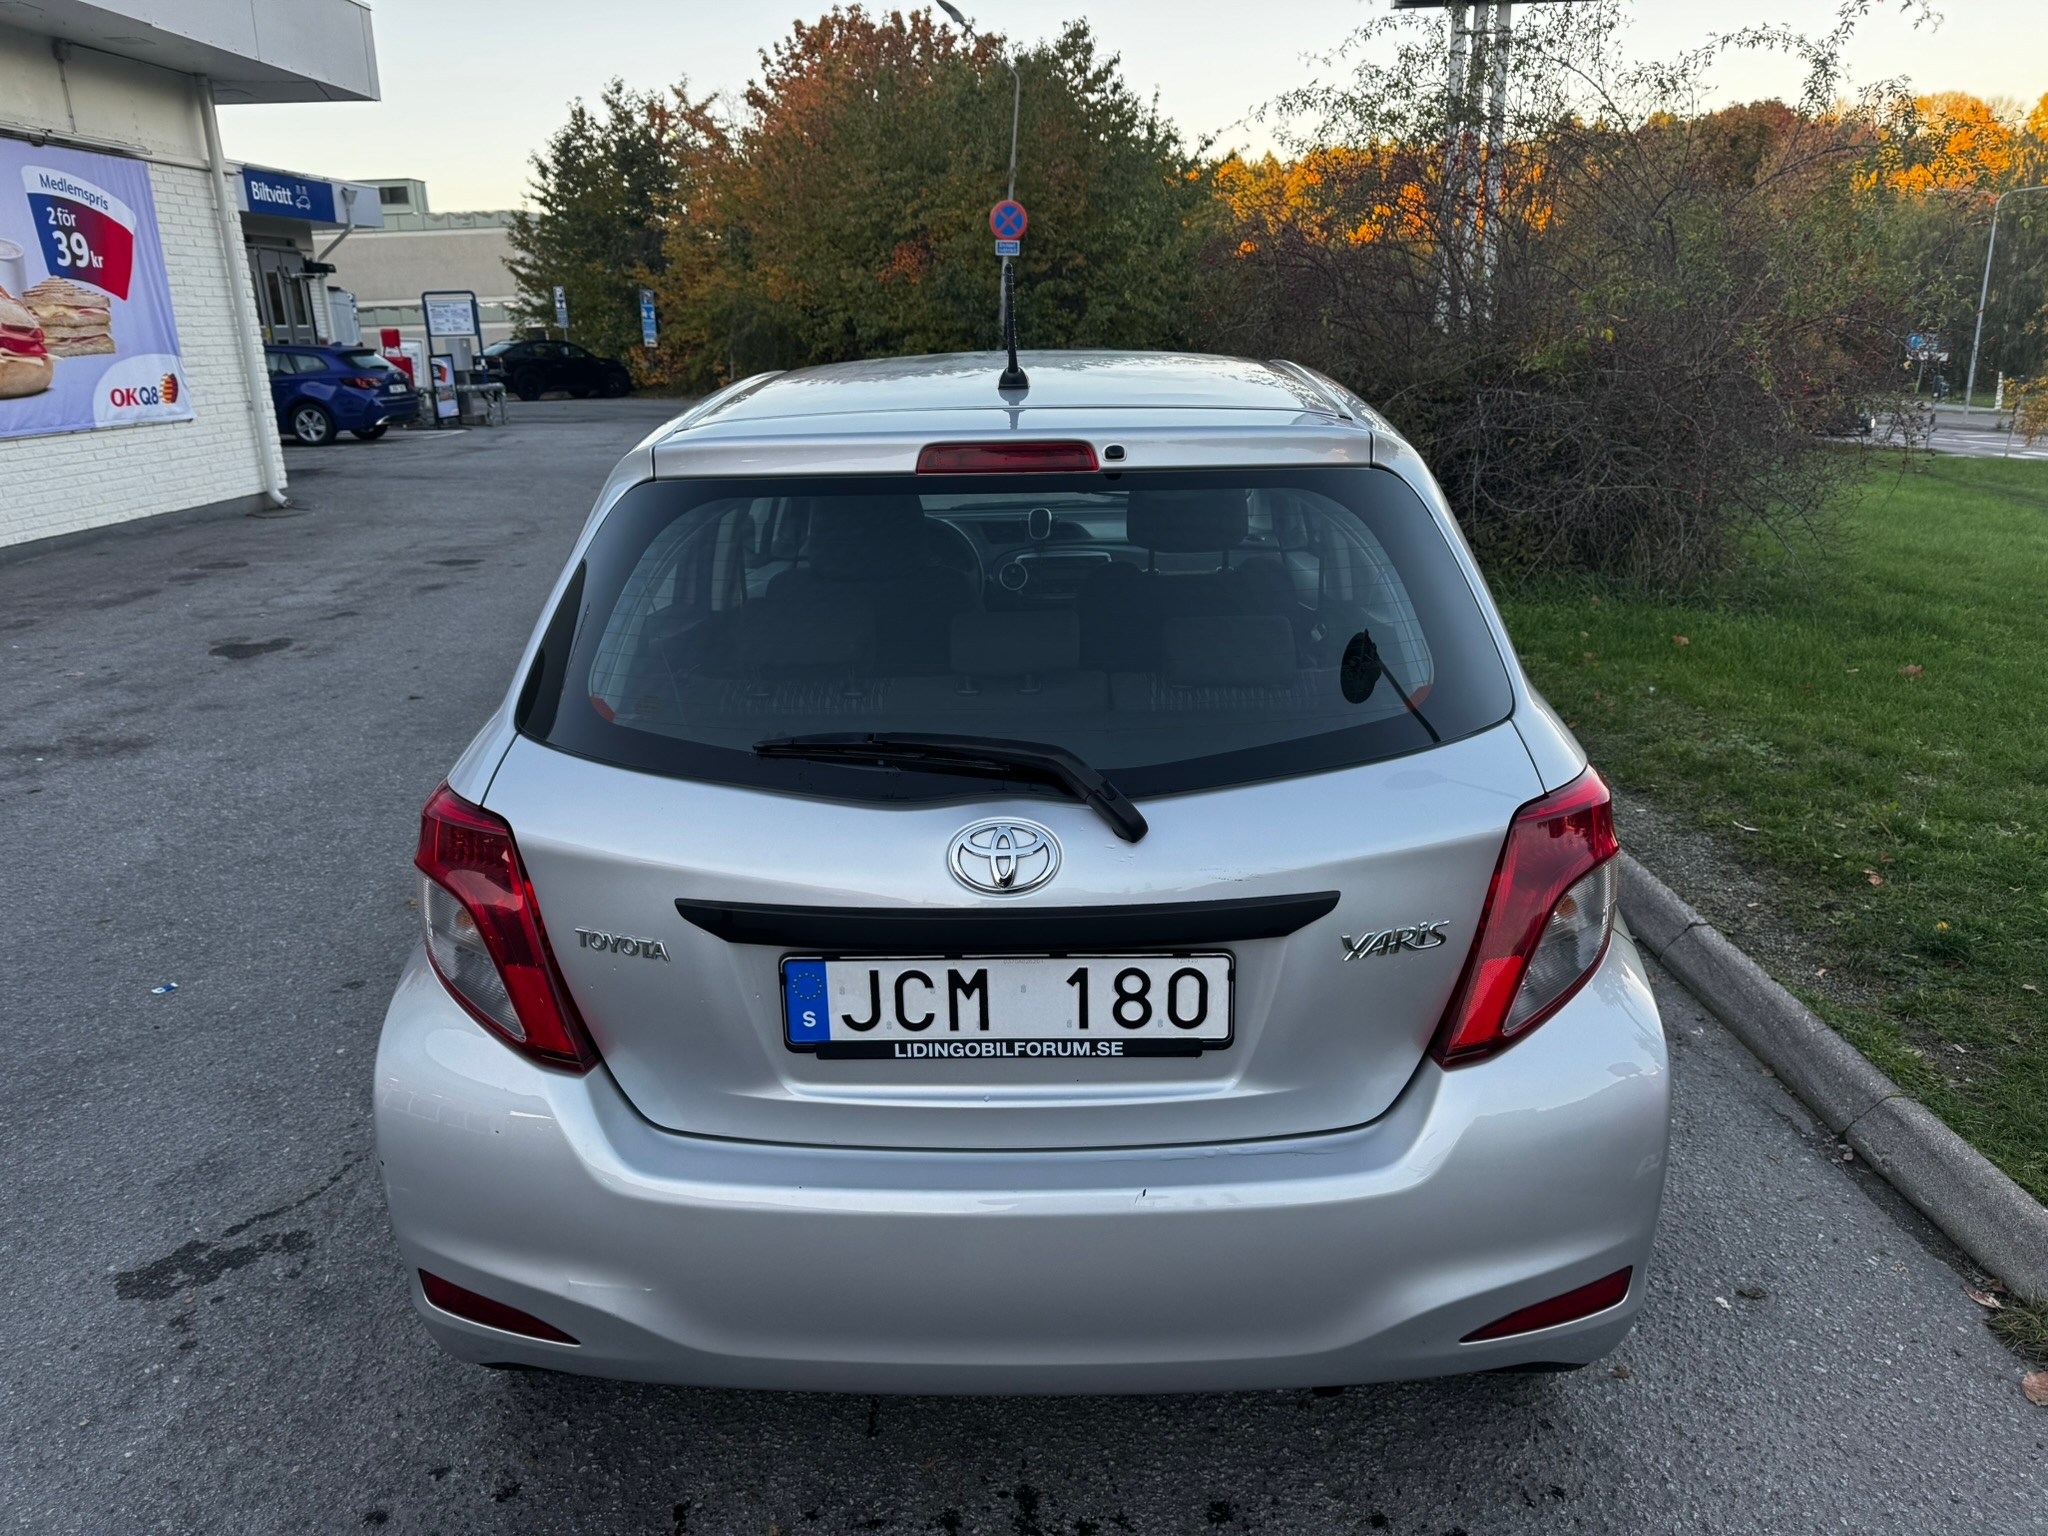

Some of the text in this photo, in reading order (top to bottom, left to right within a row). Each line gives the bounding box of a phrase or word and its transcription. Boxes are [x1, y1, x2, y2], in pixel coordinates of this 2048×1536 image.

[39, 173, 109, 211] Medlemspris
[250, 181, 293, 205] Biltvätt
[46, 207, 76, 227] 2 för
[52, 230, 89, 268] 39
[110, 386, 159, 407] OKQ8
[574, 927, 671, 961] TOYOTA
[841, 967, 1209, 1032] JCM 180
[803, 1010, 816, 1028] S
[894, 1041, 1124, 1058] LIDINGOBILFORUM.SE
